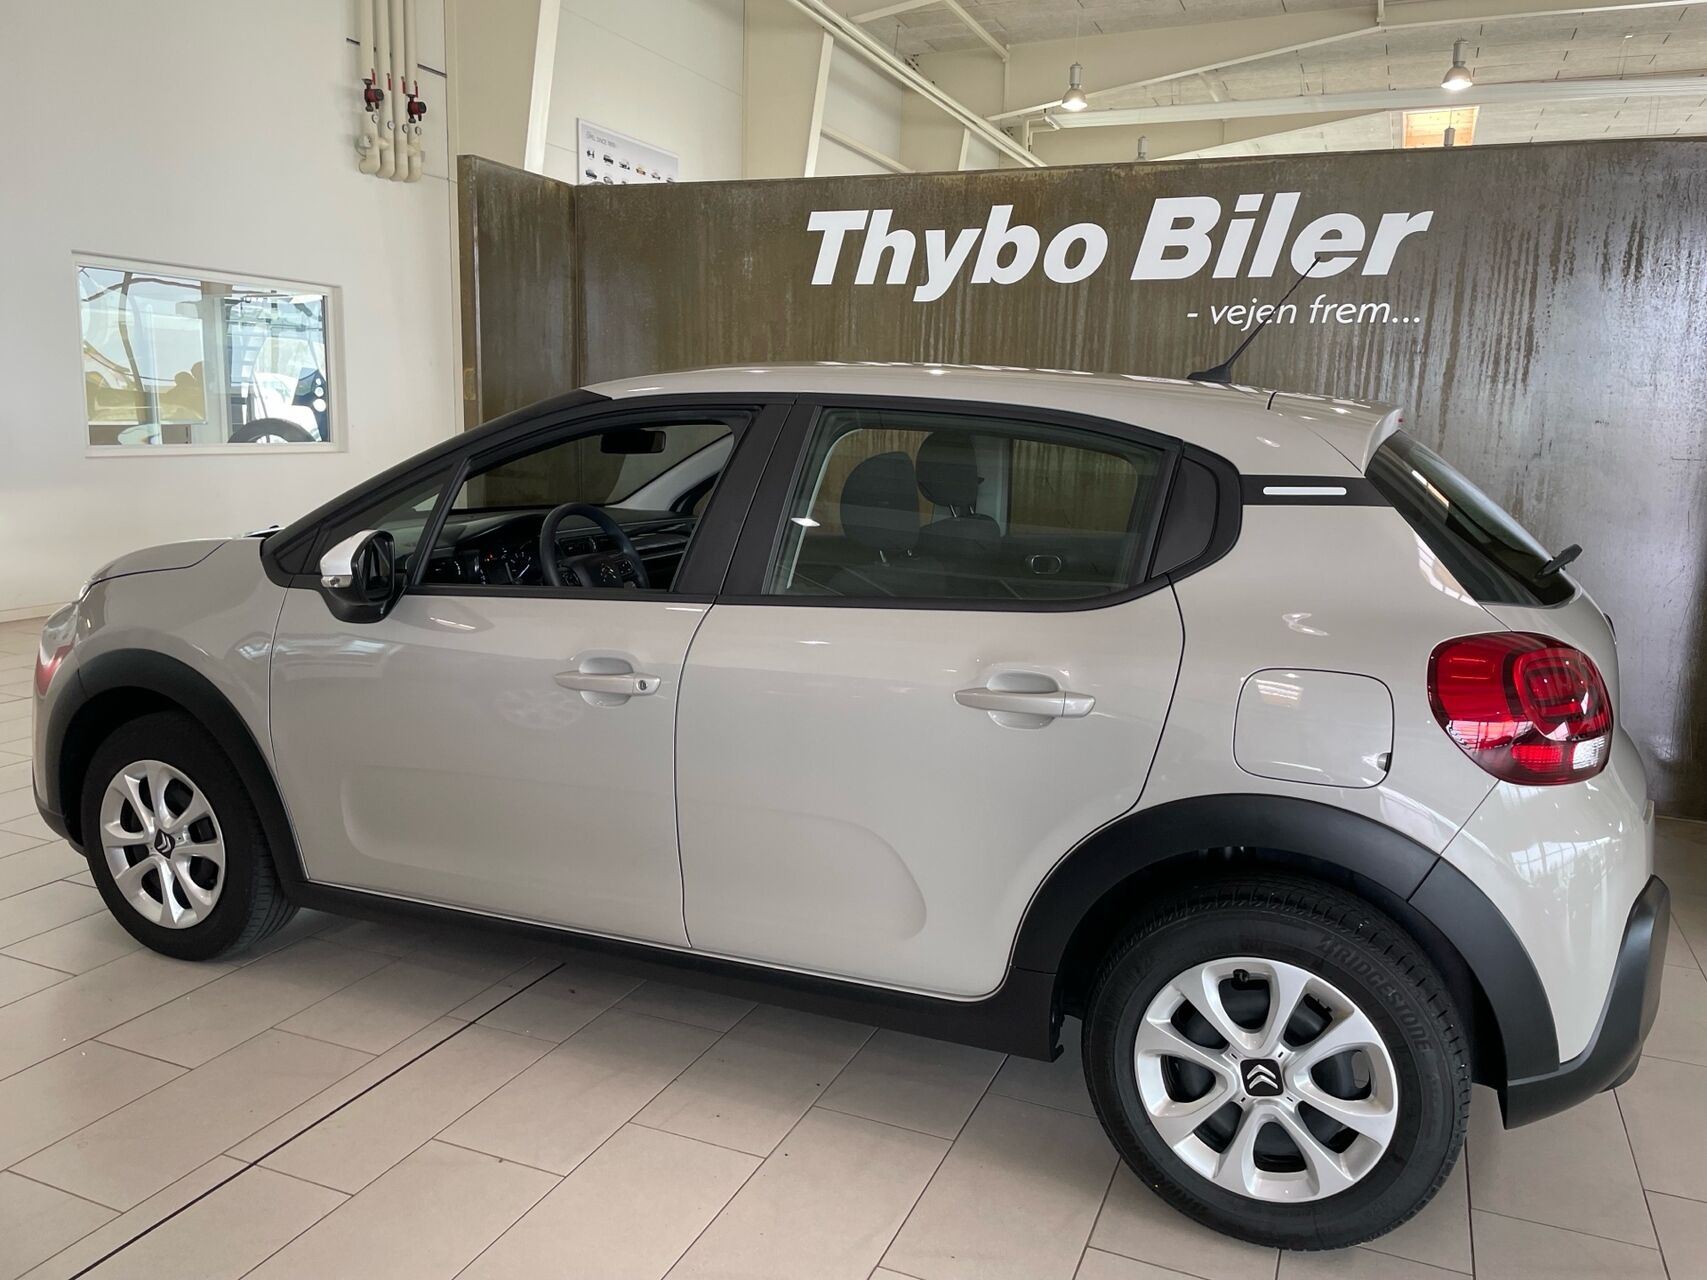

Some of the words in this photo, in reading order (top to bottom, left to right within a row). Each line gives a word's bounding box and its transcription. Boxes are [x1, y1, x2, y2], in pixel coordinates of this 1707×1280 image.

[806, 204, 1109, 303] Thybo
[1130, 191, 1434, 281] Biler
[1210, 297, 1298, 332] vejen
[1308, 293, 1421, 325] frem...
